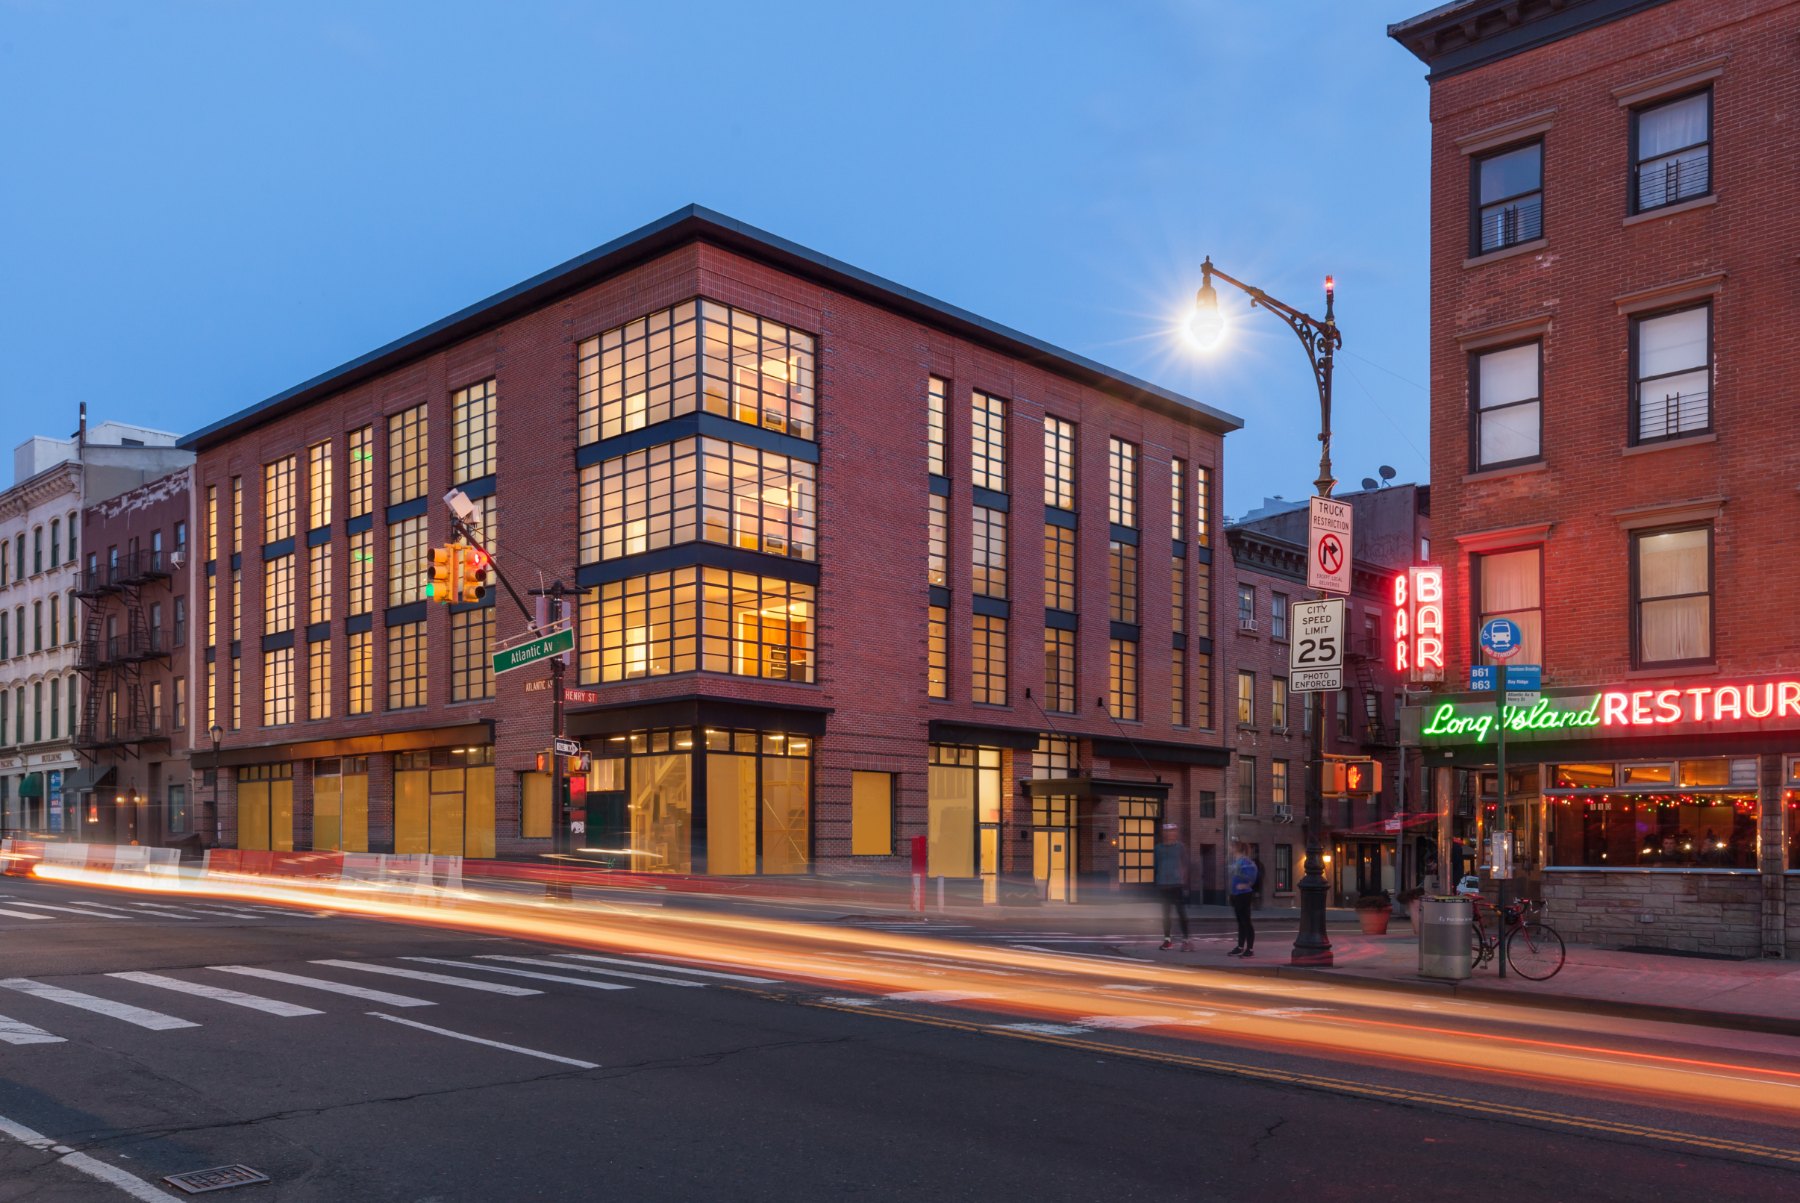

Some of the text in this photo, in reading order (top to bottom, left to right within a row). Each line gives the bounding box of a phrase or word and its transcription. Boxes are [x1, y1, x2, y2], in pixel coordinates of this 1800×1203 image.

[1319, 502, 1344, 517] TRUCK
[1313, 515, 1350, 531] RESTRICTION
[1307, 605, 1328, 614] CITY
[1302, 615, 1332, 625] SPEED
[1395, 575, 1409, 671] BAR
[1416, 572, 1443, 668] BAR
[1305, 626, 1329, 635] LIMIT
[511, 641, 553, 664] Atlantic Av
[1298, 637, 1336, 663] 25
[1493, 646, 1519, 658] STANDING
[1303, 672, 1329, 680] PHOTO
[1472, 668, 1489, 677] B61
[525, 680, 546, 692] ATLANTIC
[1295, 680, 1337, 688] ENFORCED
[1472, 681, 1490, 690] B63
[565, 690, 596, 702] HENRY ST
[1423, 703, 1493, 742] Long
[1604, 681, 1800, 726] RESTAUR
[558, 743, 566, 751] ONE
